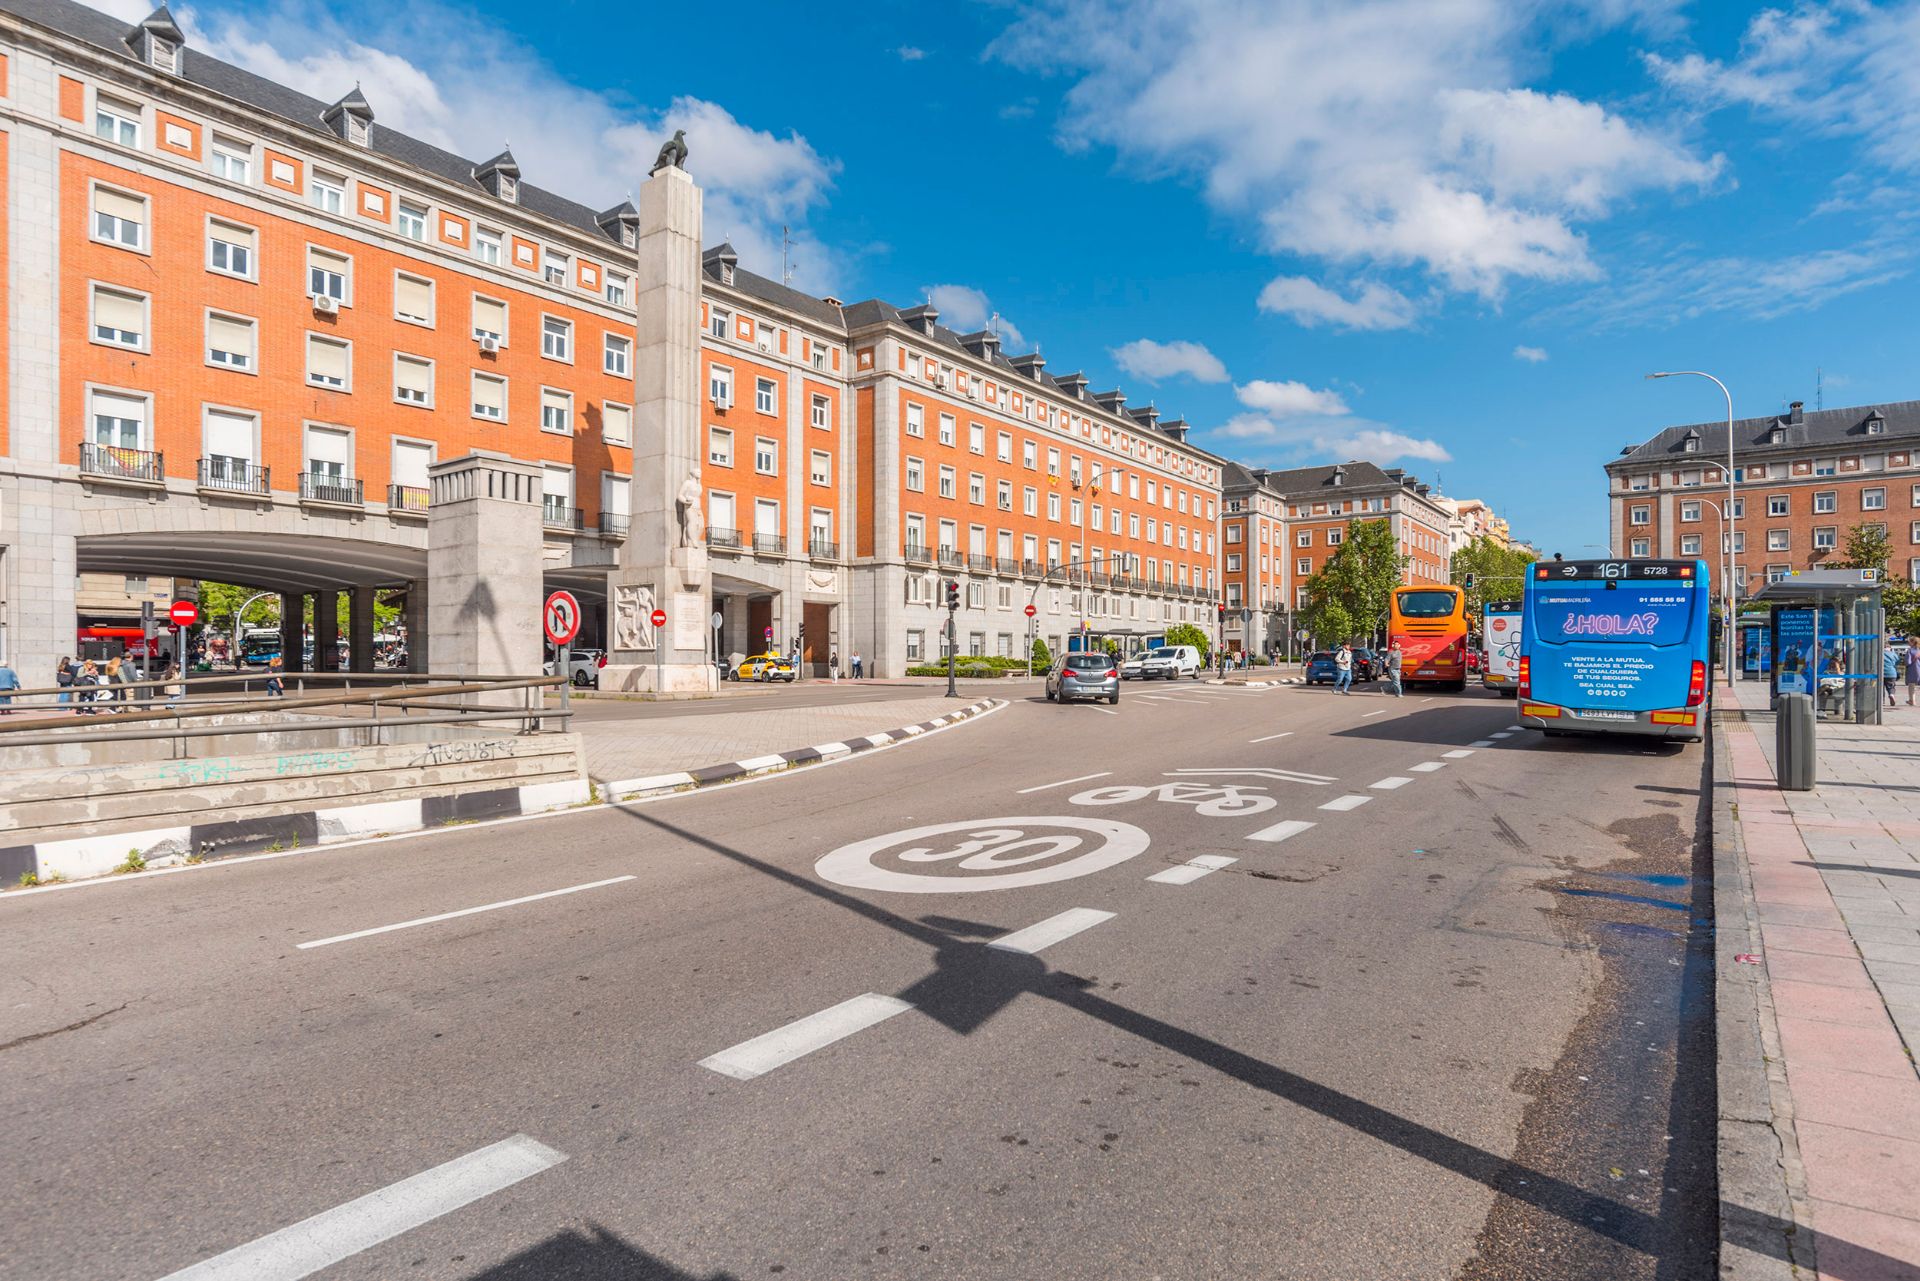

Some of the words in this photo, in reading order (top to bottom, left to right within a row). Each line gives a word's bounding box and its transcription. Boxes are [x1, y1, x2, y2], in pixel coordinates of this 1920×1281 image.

[1598, 563, 1628, 578] 161
[1643, 566, 1668, 575] 5728
[1562, 612, 1659, 636] ¿HOLA?
[898, 829, 1083, 870] 30
